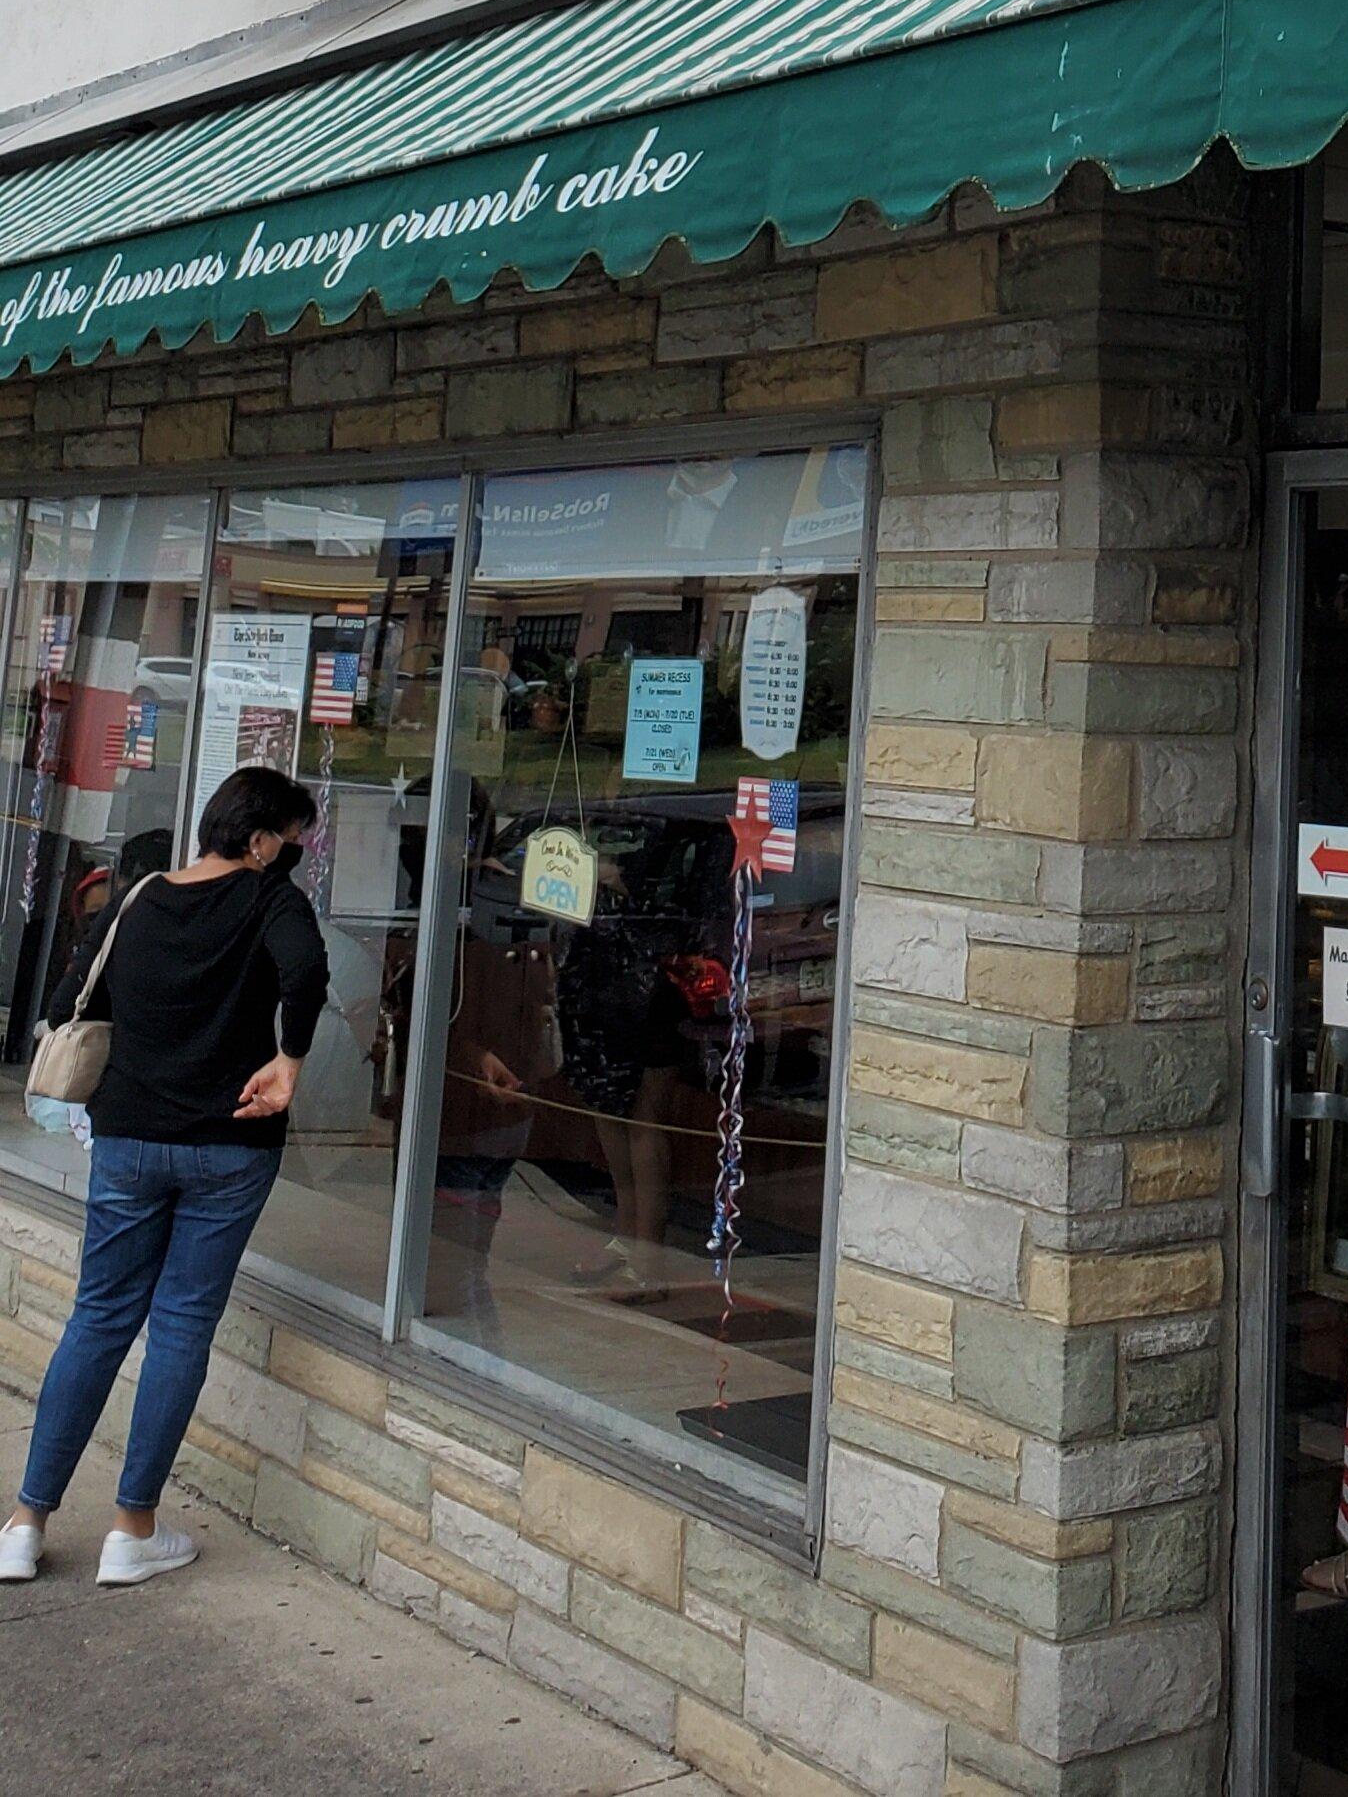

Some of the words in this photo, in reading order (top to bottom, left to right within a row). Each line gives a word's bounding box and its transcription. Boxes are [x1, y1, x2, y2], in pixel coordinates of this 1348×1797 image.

[0, 271, 42, 347] of
[37, 266, 94, 319] the
[77, 253, 231, 335] famous
[234, 220, 381, 289] heavy
[380, 153, 555, 250] crumb
[556, 126, 704, 213] cake
[651, 724, 673, 734] CLOSED
[536, 875, 579, 912] OPEN
